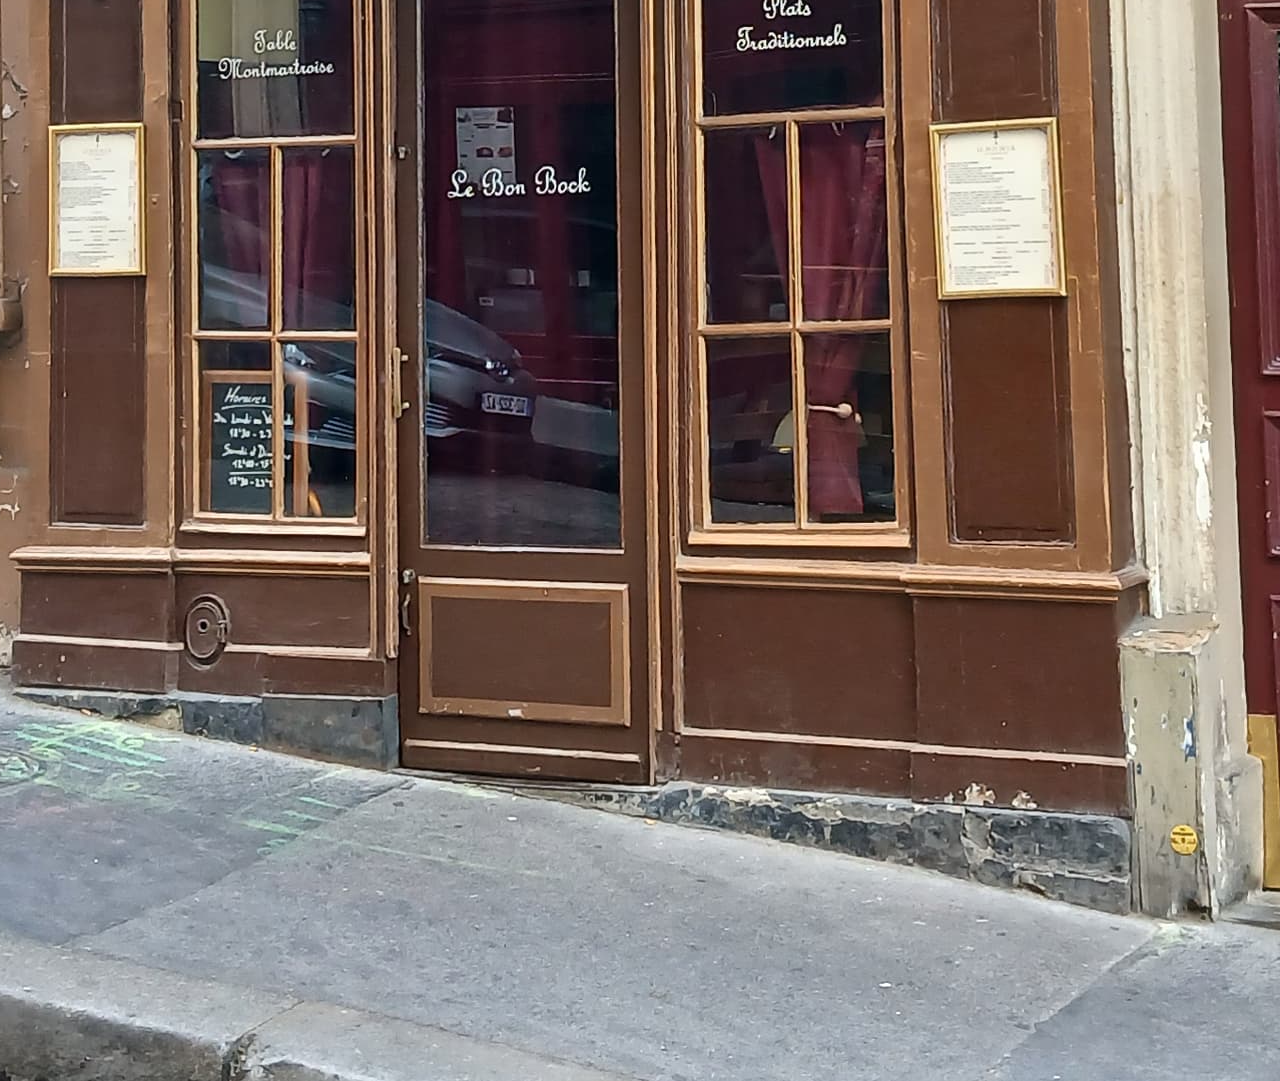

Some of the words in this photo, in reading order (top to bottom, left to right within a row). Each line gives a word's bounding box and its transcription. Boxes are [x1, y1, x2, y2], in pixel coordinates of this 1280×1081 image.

[253, 29, 297, 54] Table
[736, 23, 847, 51] Traditionnels
[218, 57, 335, 81] Montmartroise
[447, 169, 475, 199] Le
[482, 167, 526, 197] Bon
[534, 165, 591, 195] Bock
